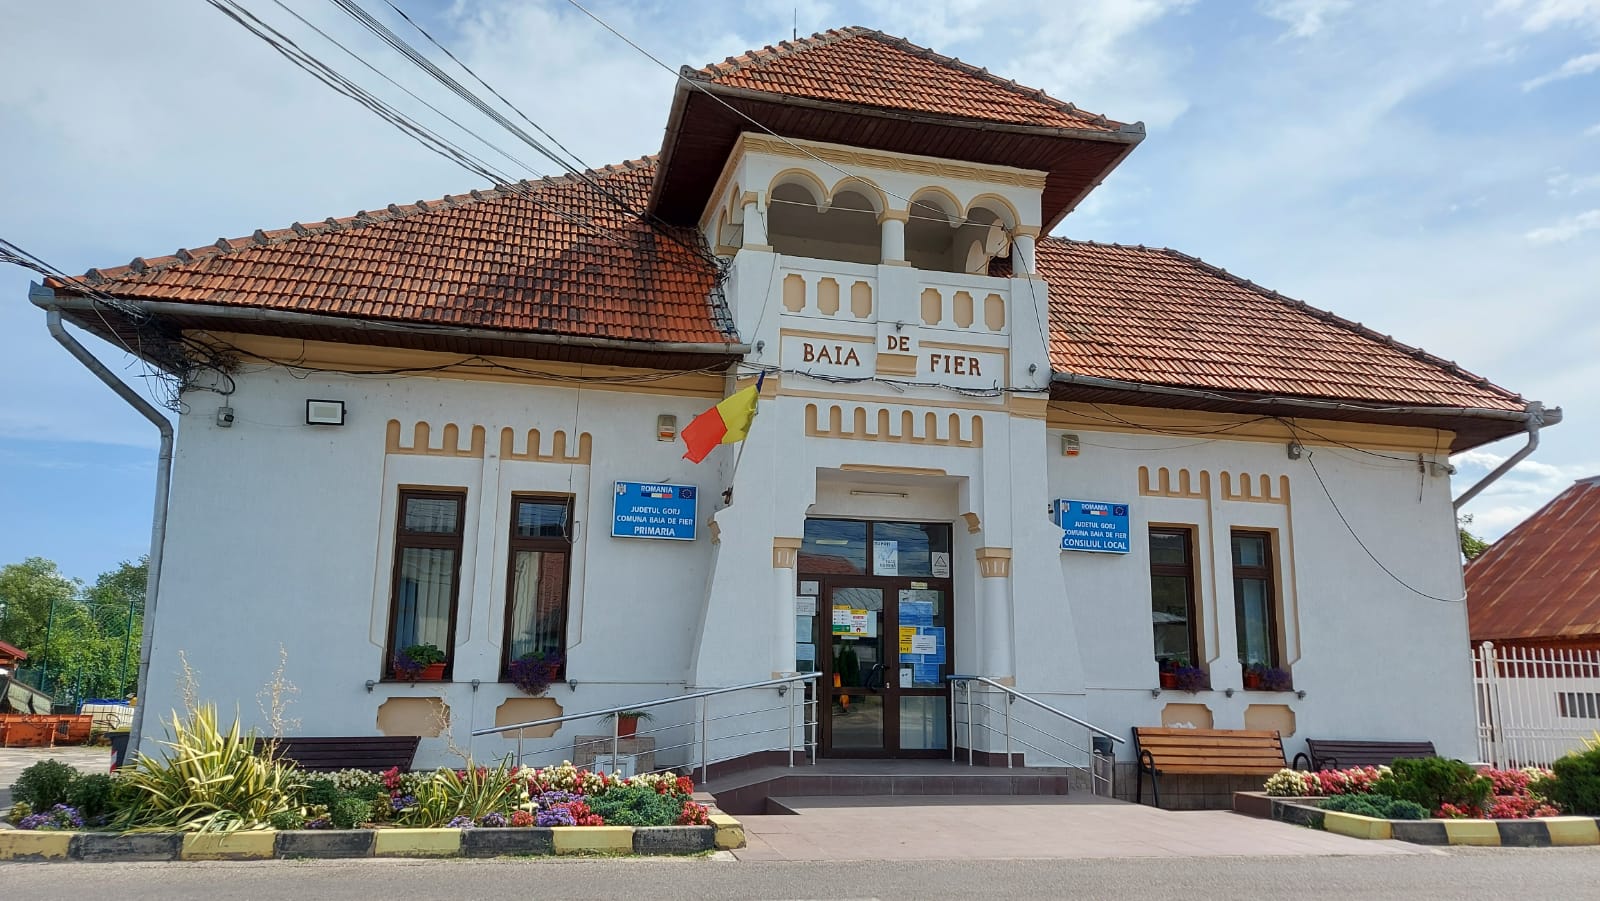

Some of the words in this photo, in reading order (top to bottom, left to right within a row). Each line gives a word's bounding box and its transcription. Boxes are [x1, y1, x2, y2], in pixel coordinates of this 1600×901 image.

[803, 342, 860, 367] BAIA
[887, 335, 910, 352] DE
[930, 353, 981, 377] FIER
[616, 515, 647, 523] COMUNA
[1100, 522, 1116, 530] GORJ
[634, 527, 675, 536] PRIMARIA
[1064, 539, 1102, 548] CONSILIUL
